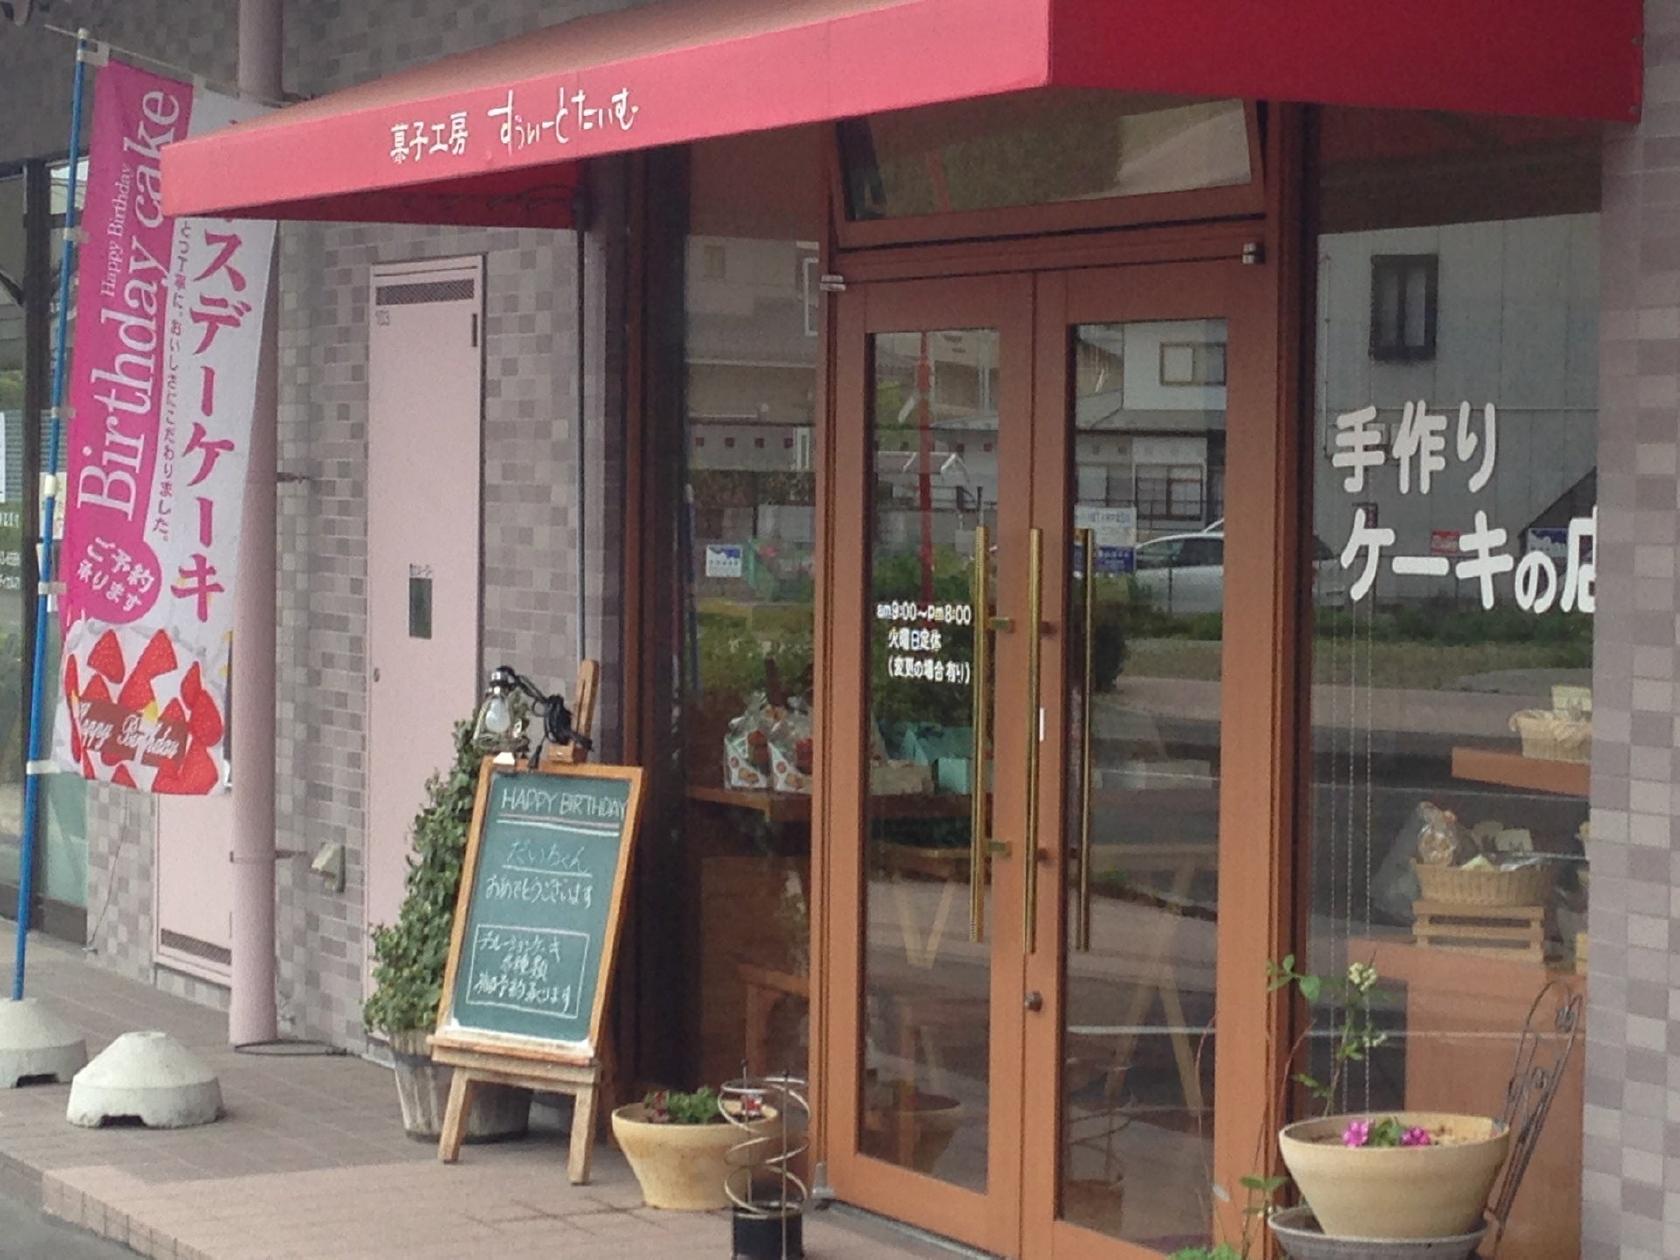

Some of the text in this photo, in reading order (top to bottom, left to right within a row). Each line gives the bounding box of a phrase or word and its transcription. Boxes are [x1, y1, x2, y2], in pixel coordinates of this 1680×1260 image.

[389, 111, 468, 164] 菓子工房
[100, 163, 134, 298] Happy Birthday
[76, 90, 180, 523] Birthday cake
[169, 217, 253, 623] スデーケーキ
[1331, 400, 1496, 494] 手作り
[76, 558, 143, 612] 承ります
[86, 536, 155, 594] ご予約
[888, 626, 942, 651] 火曜日定休
[501, 786, 630, 821] HAPPY BIRTHDAY
